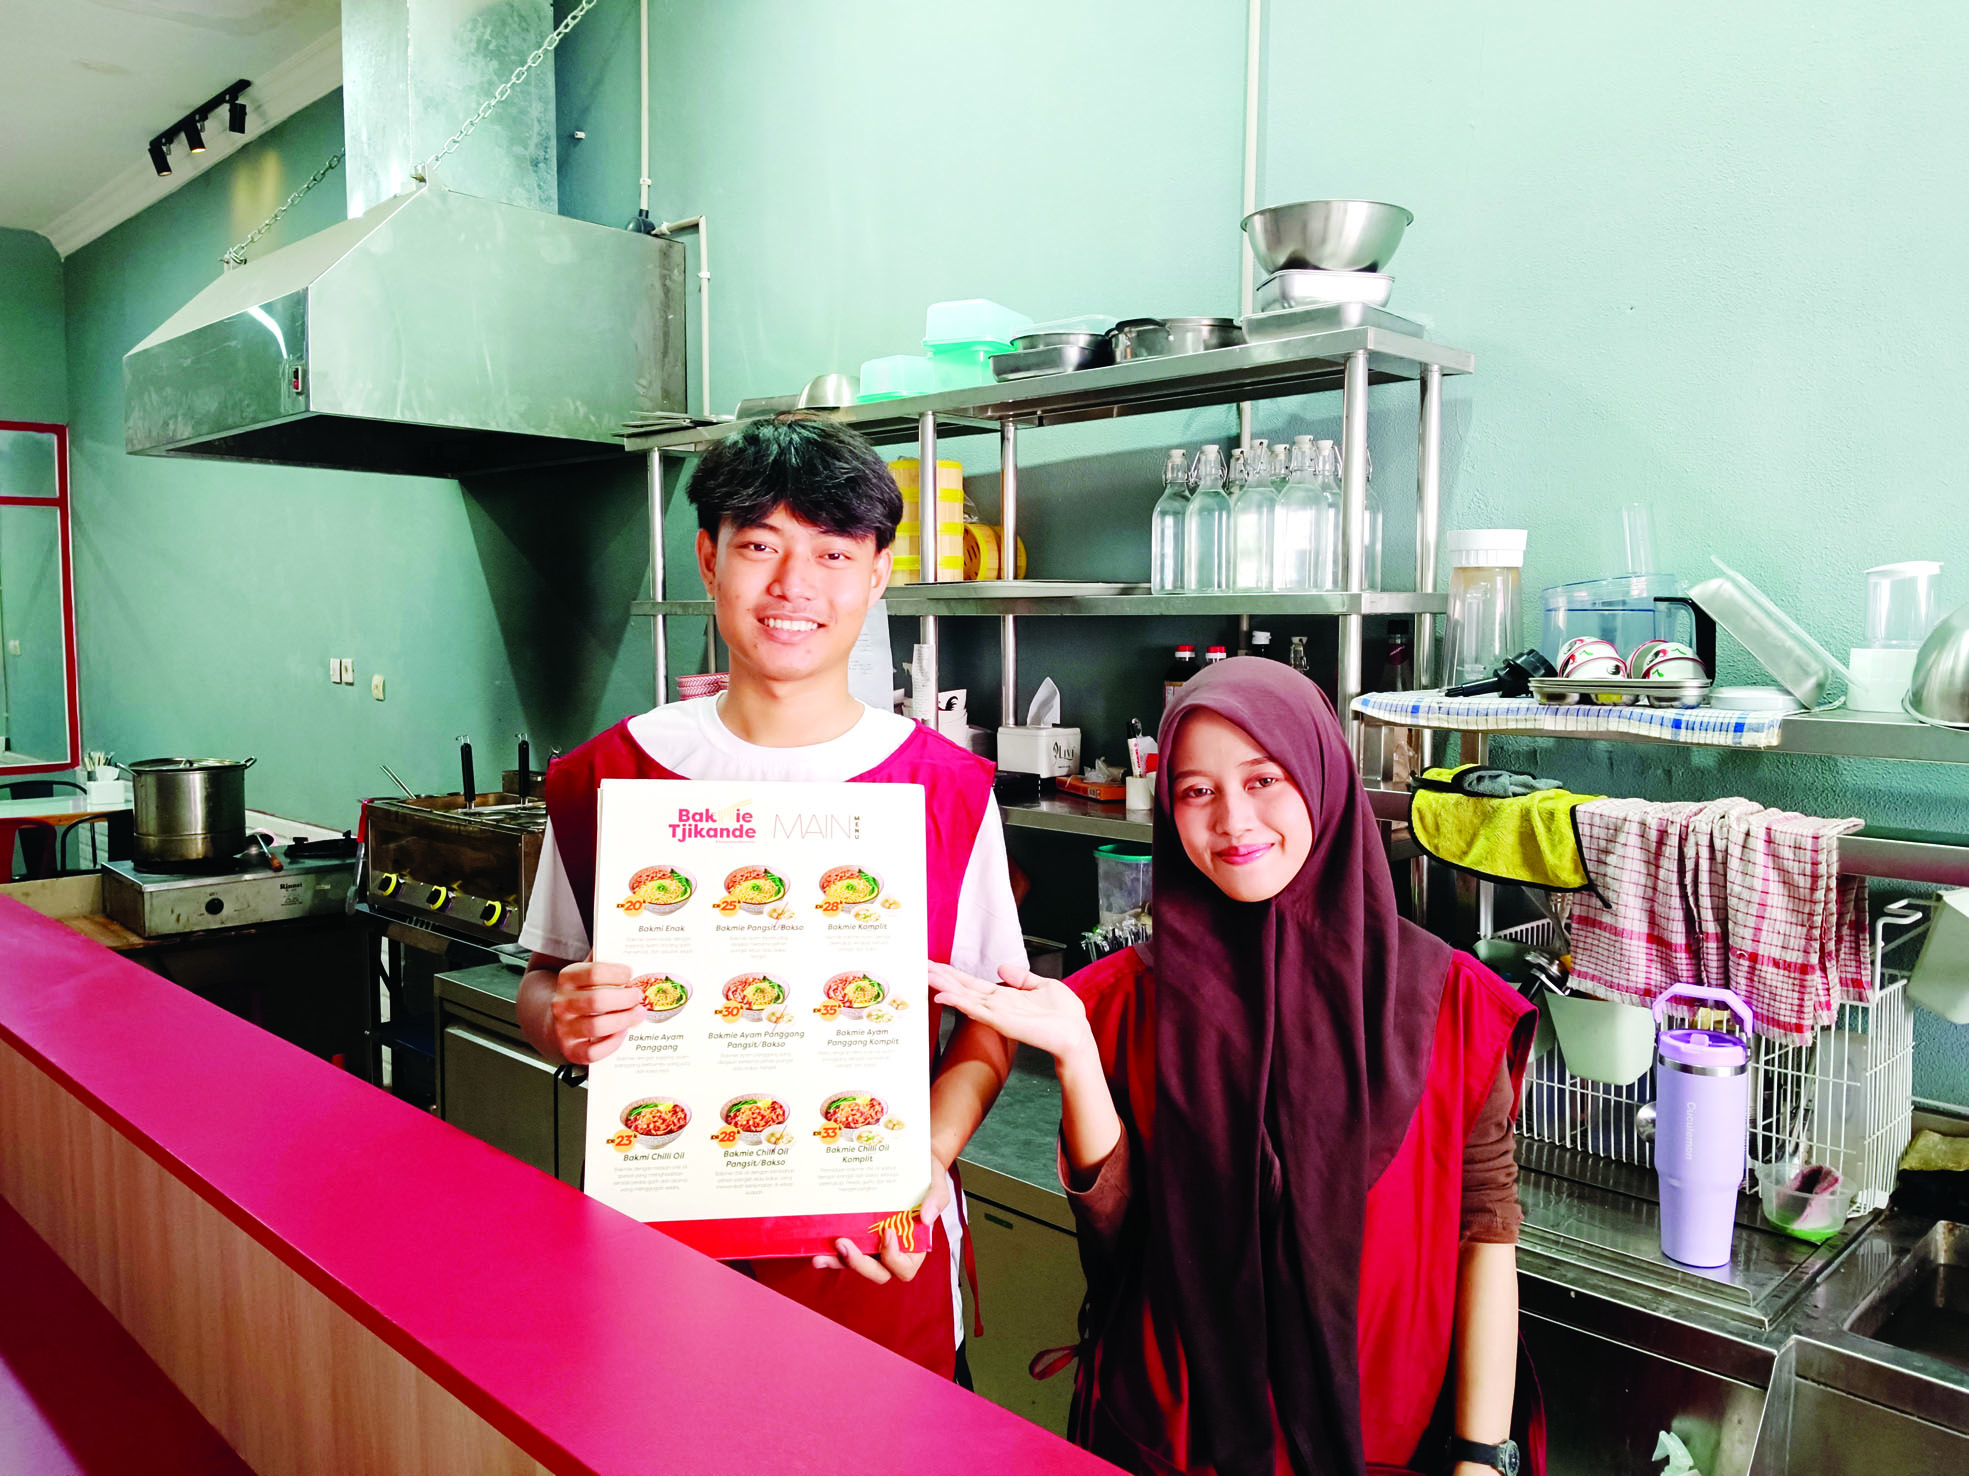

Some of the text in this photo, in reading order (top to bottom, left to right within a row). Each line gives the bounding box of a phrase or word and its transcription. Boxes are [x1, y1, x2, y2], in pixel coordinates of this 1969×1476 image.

[678, 807, 753, 823] Bakie
[773, 813, 851, 840] MAIN
[668, 823, 757, 843] Tjikande
[280, 882, 303, 890] Rinnai
[857, 923, 888, 931] Komplit
[660, 1034, 684, 1042] Ayam
[763, 1031, 805, 1039] Panggang
[827, 1038, 899, 1047] Panggang Komplit
[635, 1044, 679, 1052] Panggang
[857, 1144, 877, 1152] Chilli
[623, 1151, 685, 1161] Bakmi Chilli Oil
[842, 1155, 873, 1164] Komplit
